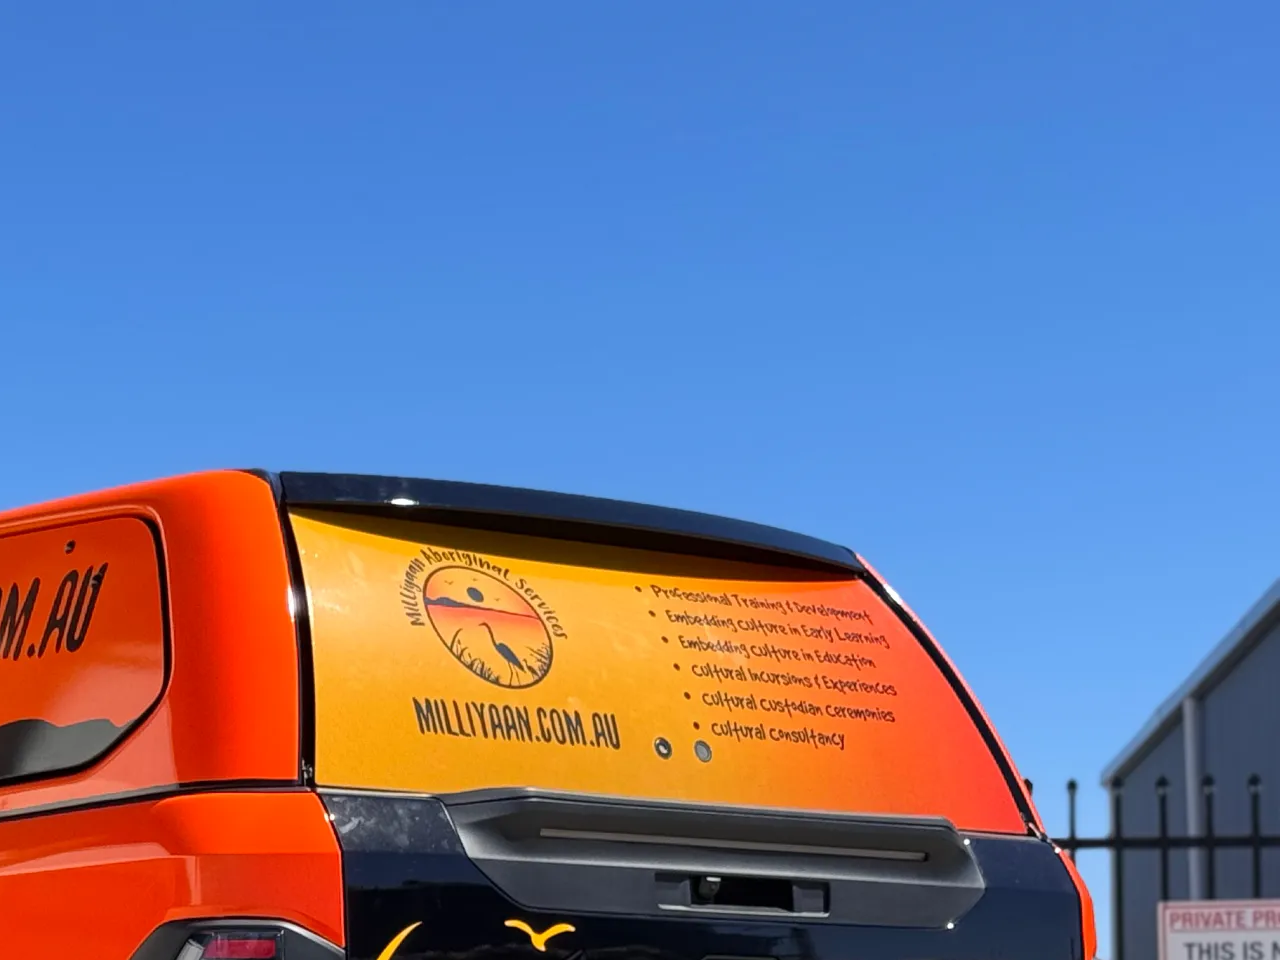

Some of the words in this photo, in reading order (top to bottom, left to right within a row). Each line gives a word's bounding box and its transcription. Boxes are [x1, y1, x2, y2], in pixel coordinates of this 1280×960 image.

[420, 546, 511, 582] Aboriginal
[515, 577, 568, 640] Services
[650, 584, 732, 607] Professional
[731, 594, 788, 616] Training
[796, 601, 873, 625] Development
[666, 610, 737, 632] Embedding
[790, 621, 801, 637] in
[801, 624, 835, 643] Early
[835, 628, 890, 650] Learning
[678, 635, 750, 659] Embedding
[802, 647, 814, 662] in
[815, 650, 877, 671] Education
[691, 663, 747, 684] Cultural
[822, 676, 898, 698] Experiences
[702, 690, 758, 712] Cultural
[412, 696, 621, 750] MILLIYAAN.COM.AU
[711, 721, 766, 742] Cultural
[1170, 911, 1246, 929] PRIVATE
